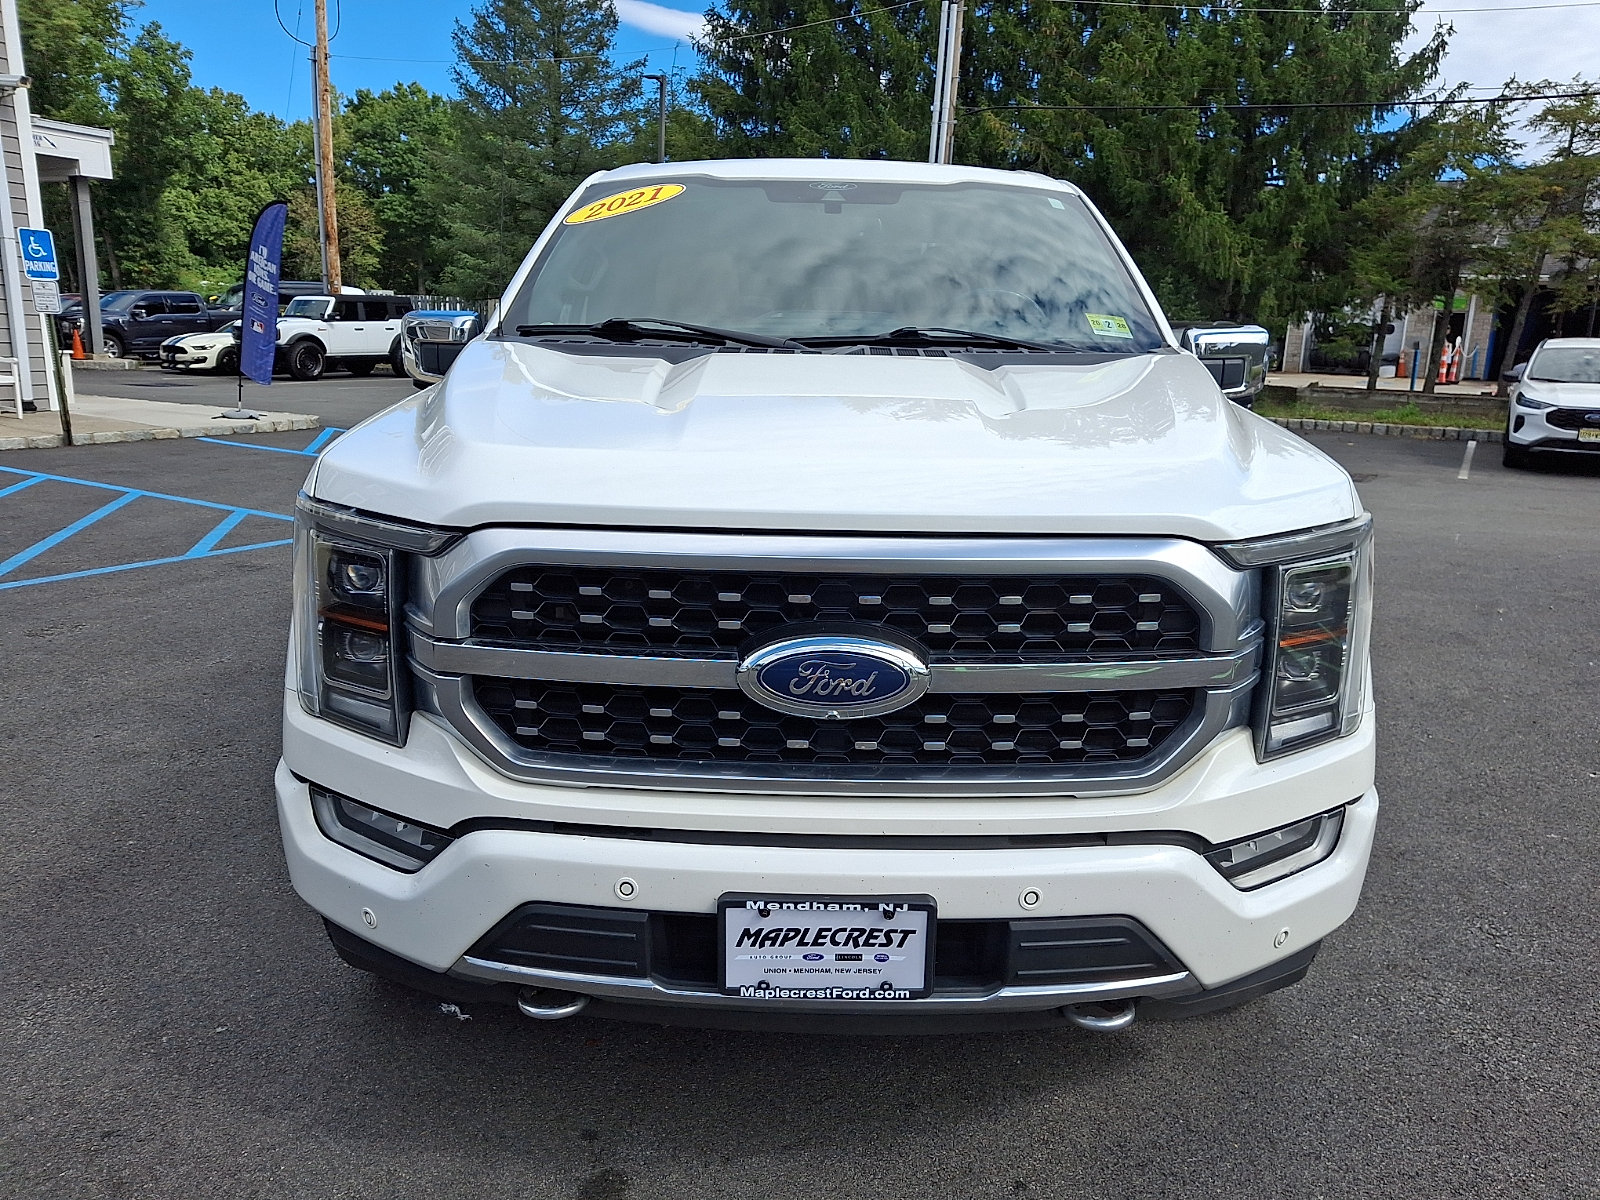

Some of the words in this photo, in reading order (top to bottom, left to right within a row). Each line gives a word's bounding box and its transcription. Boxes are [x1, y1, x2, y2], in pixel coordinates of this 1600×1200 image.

[583, 186, 665, 220] 2021
[24, 259, 57, 273] PARKING
[1104, 320, 1113, 329] 2
[788, 659, 879, 697] Ford
[746, 900, 869, 912] Mendham,
[878, 903, 909, 912] NJ
[735, 927, 917, 949] MAPLECREST
[793, 967, 833, 975] MENDHAM,
[740, 986, 910, 1000] MaplecrestFord.com
